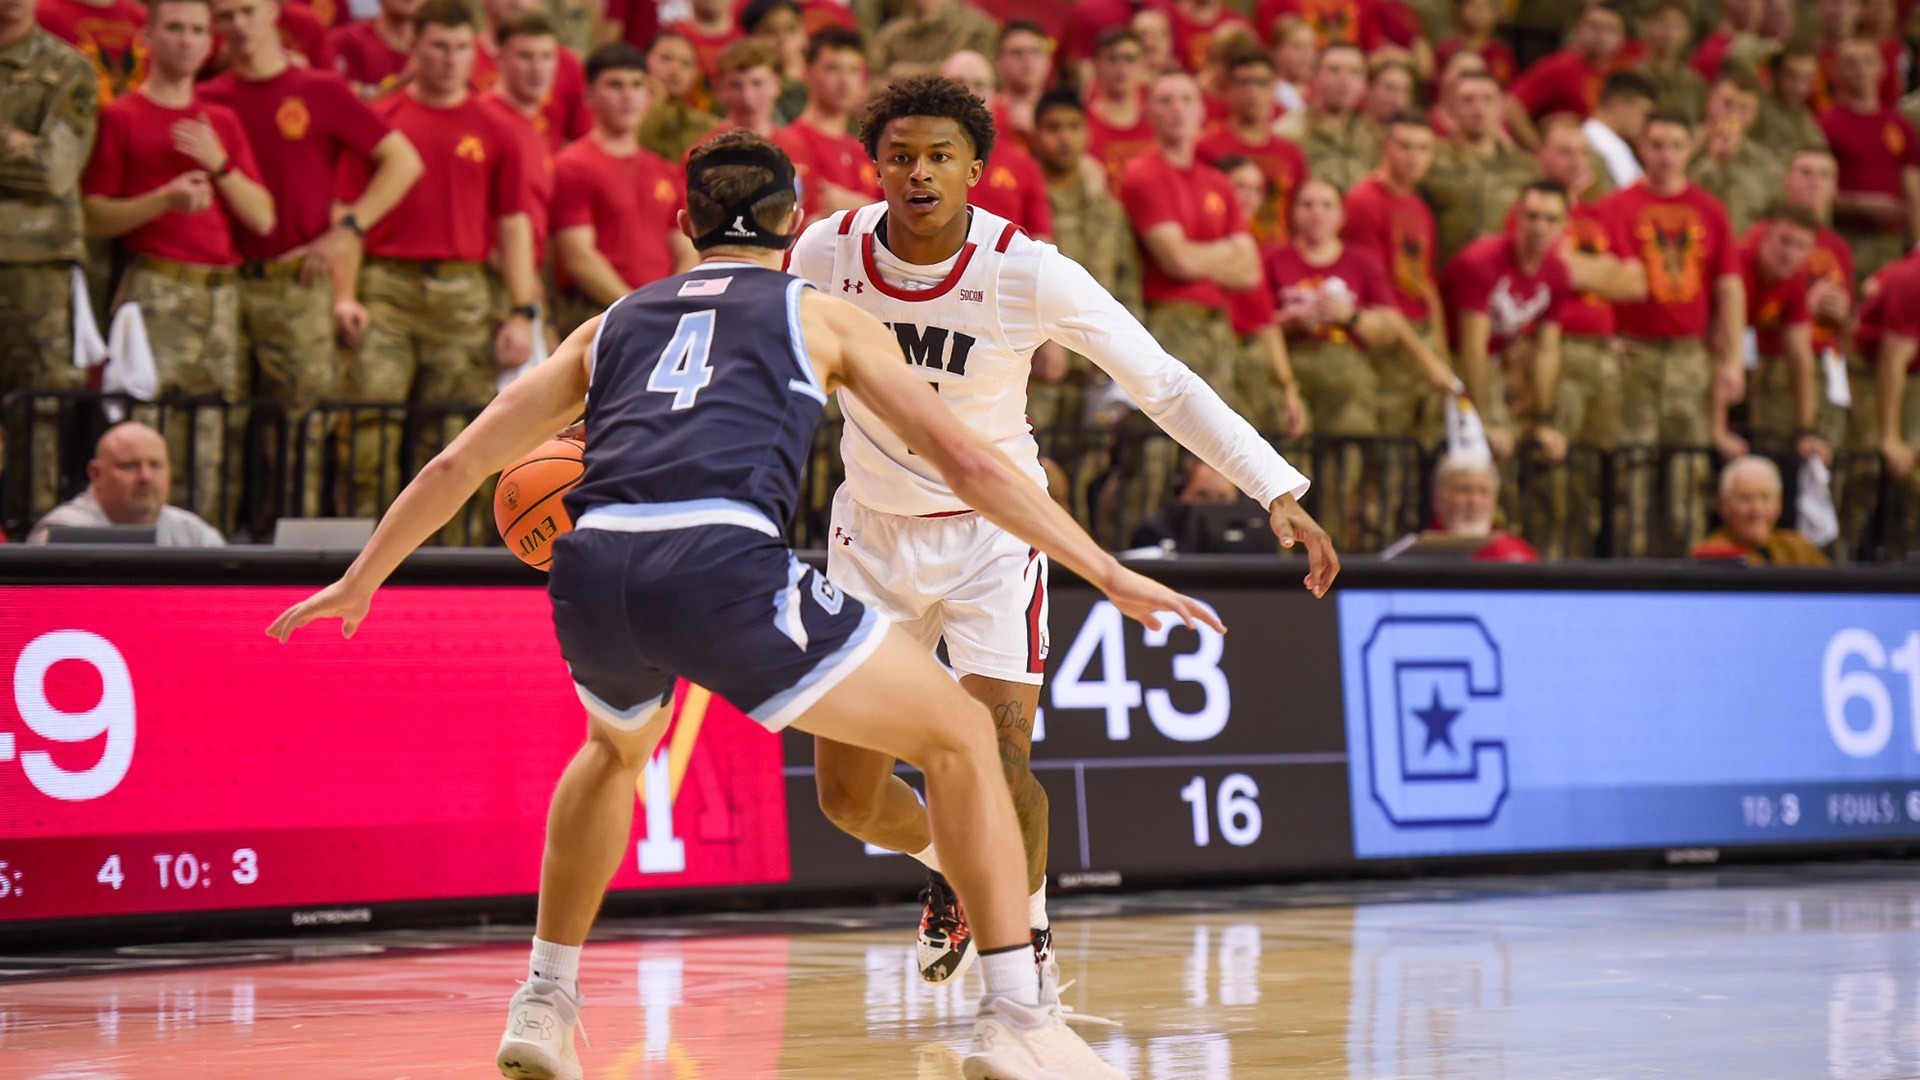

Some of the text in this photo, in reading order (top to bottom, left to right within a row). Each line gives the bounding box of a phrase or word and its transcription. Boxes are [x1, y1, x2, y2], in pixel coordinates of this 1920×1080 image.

[959, 288, 984, 303] SOCON
[646, 308, 717, 411] 4
[882, 321, 977, 376] MI
[0, 628, 137, 802] 9
[1362, 614, 1510, 828] C
[1822, 627, 1920, 759] 61
[1180, 772, 1263, 846] 16
[96, 853, 125, 891] 4
[152, 851, 211, 890] TO:
[231, 847, 259, 885] 3
